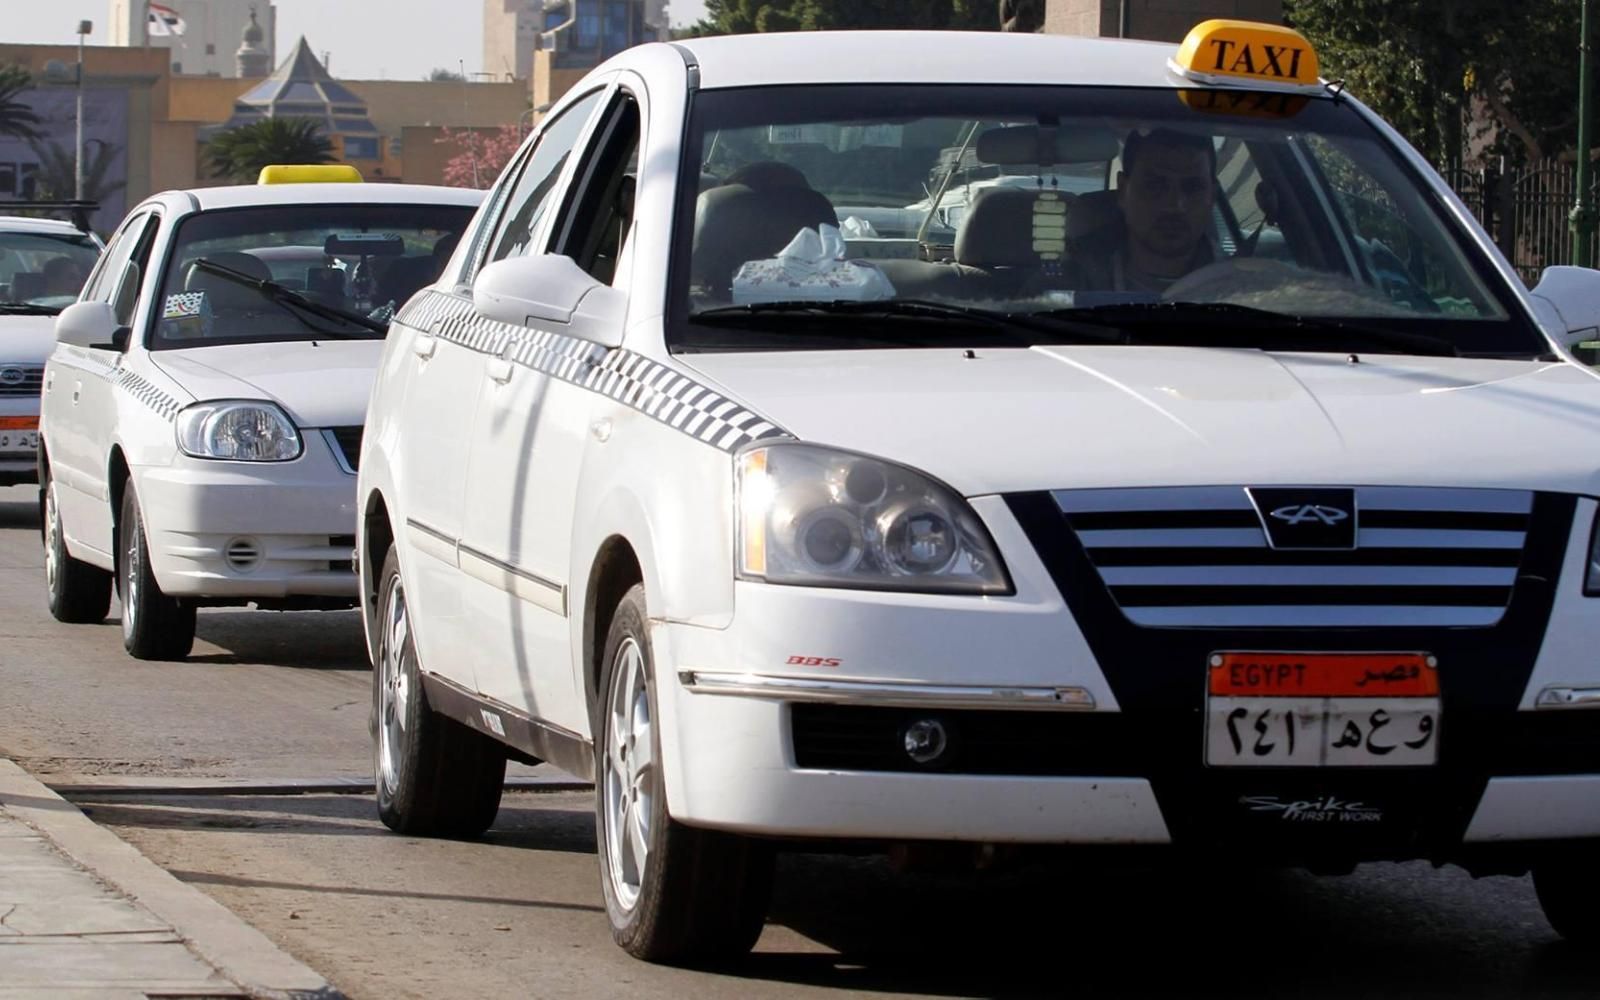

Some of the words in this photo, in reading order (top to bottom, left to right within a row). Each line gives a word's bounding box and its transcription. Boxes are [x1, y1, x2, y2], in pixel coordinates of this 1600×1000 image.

[1210, 39, 1304, 79] TAXI
[785, 656, 843, 667] BBS
[1229, 664, 1306, 687] EGYPT
[1355, 664, 1420, 687] مصر
[1227, 708, 1295, 756] ٢٤١
[1291, 811, 1335, 822] FIRST
[1339, 811, 1383, 822] WORK
